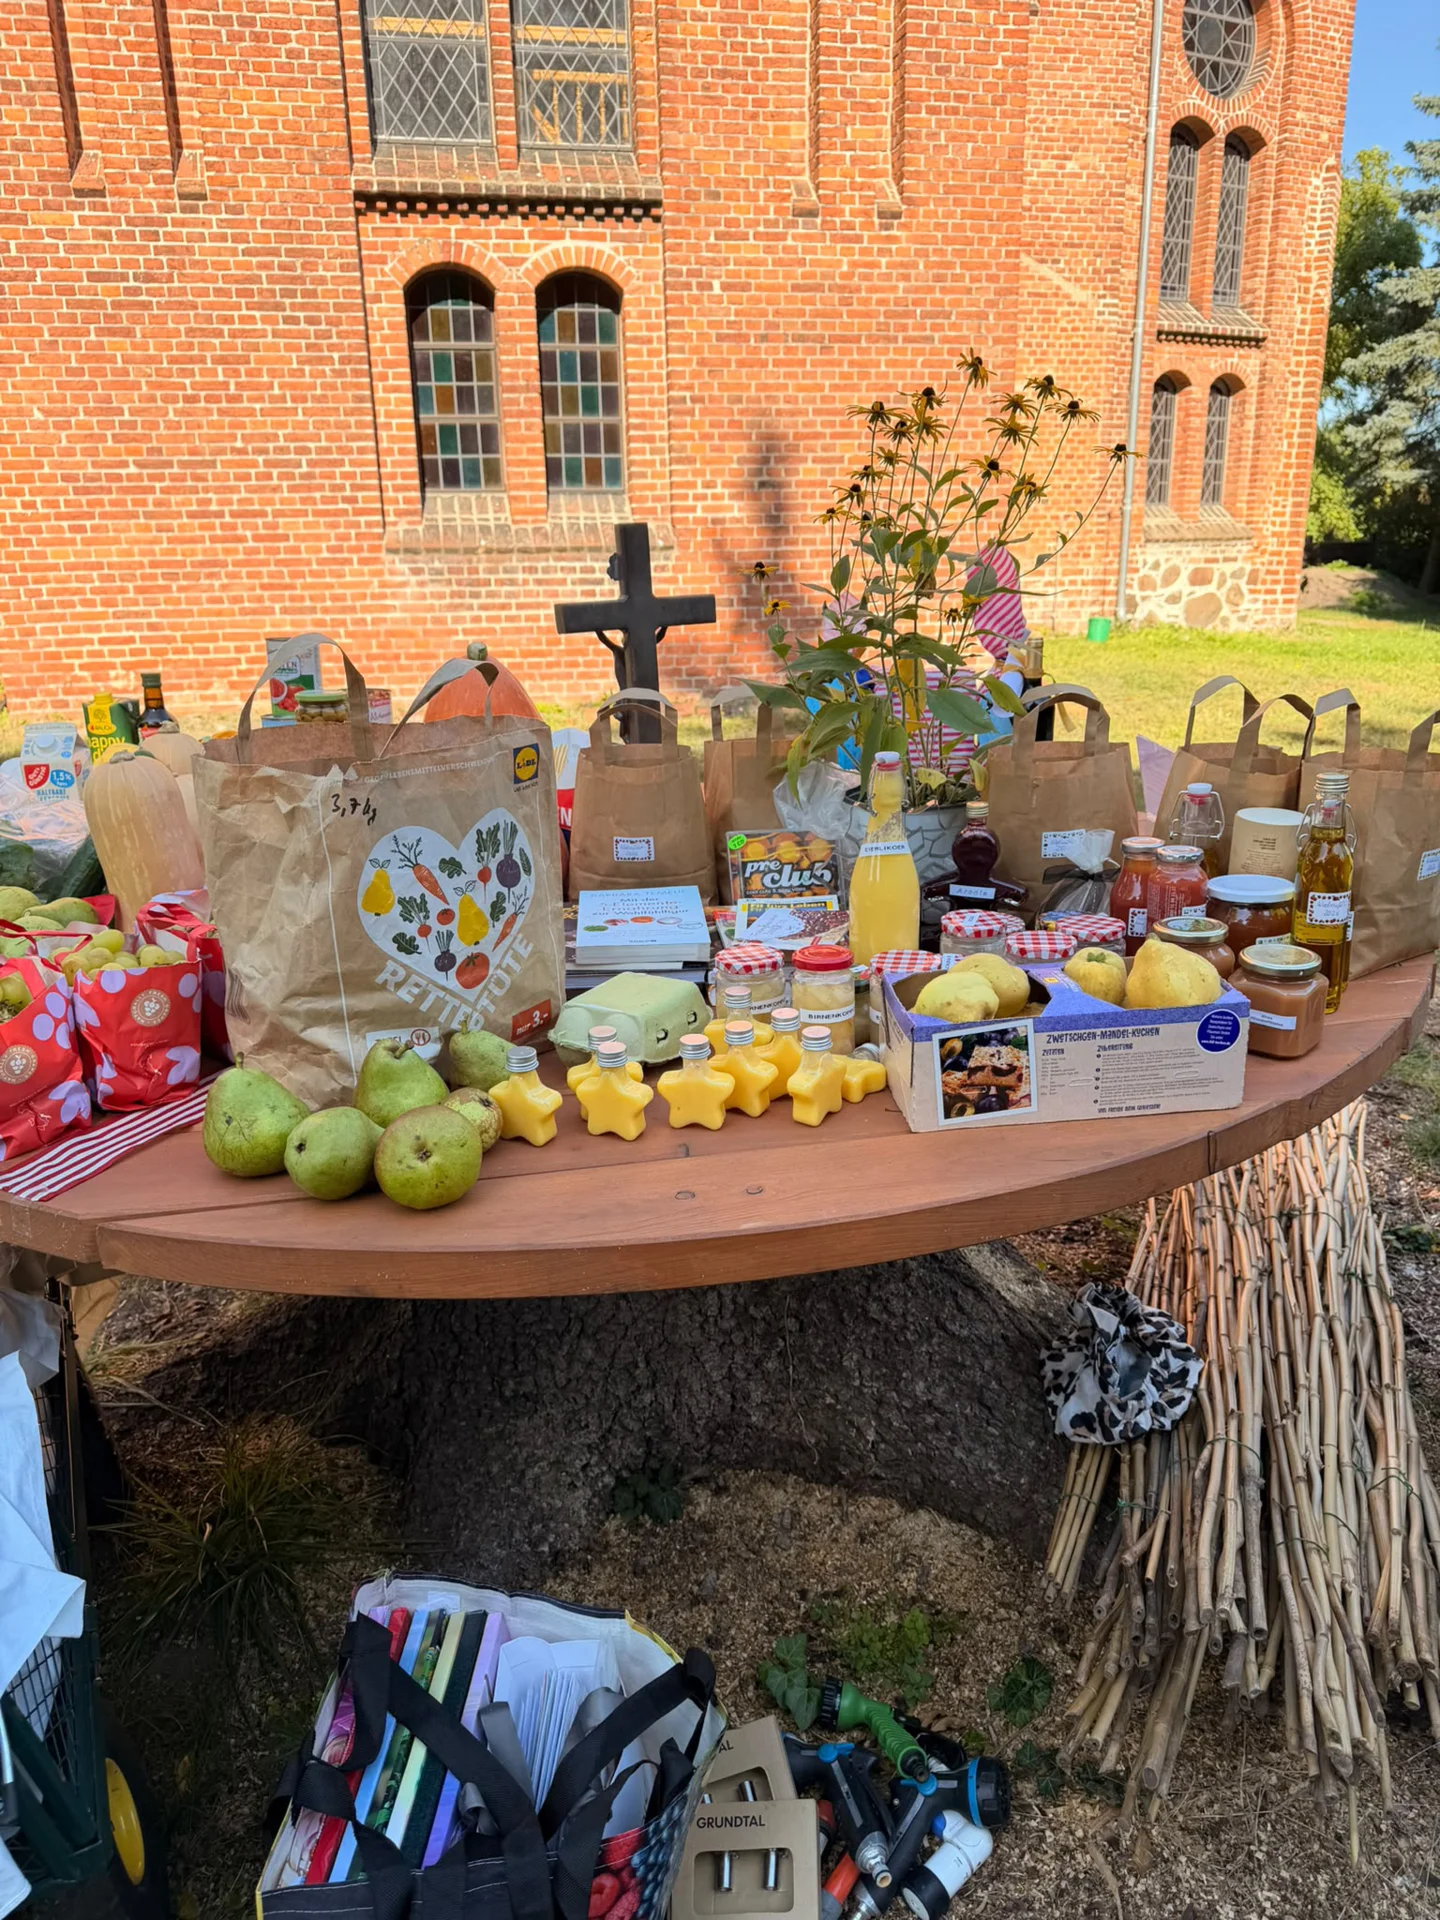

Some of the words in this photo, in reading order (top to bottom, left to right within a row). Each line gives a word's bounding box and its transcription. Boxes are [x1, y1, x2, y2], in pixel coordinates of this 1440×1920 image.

[89, 736, 126, 752] appy
[516, 758, 537, 770] LIDL
[744, 860, 781, 877] pre
[762, 862, 832, 888] club
[476, 933, 534, 1014] TÜTE
[375, 960, 485, 1032] RETTER
[696, 1815, 766, 1829] GRUNDTAL
